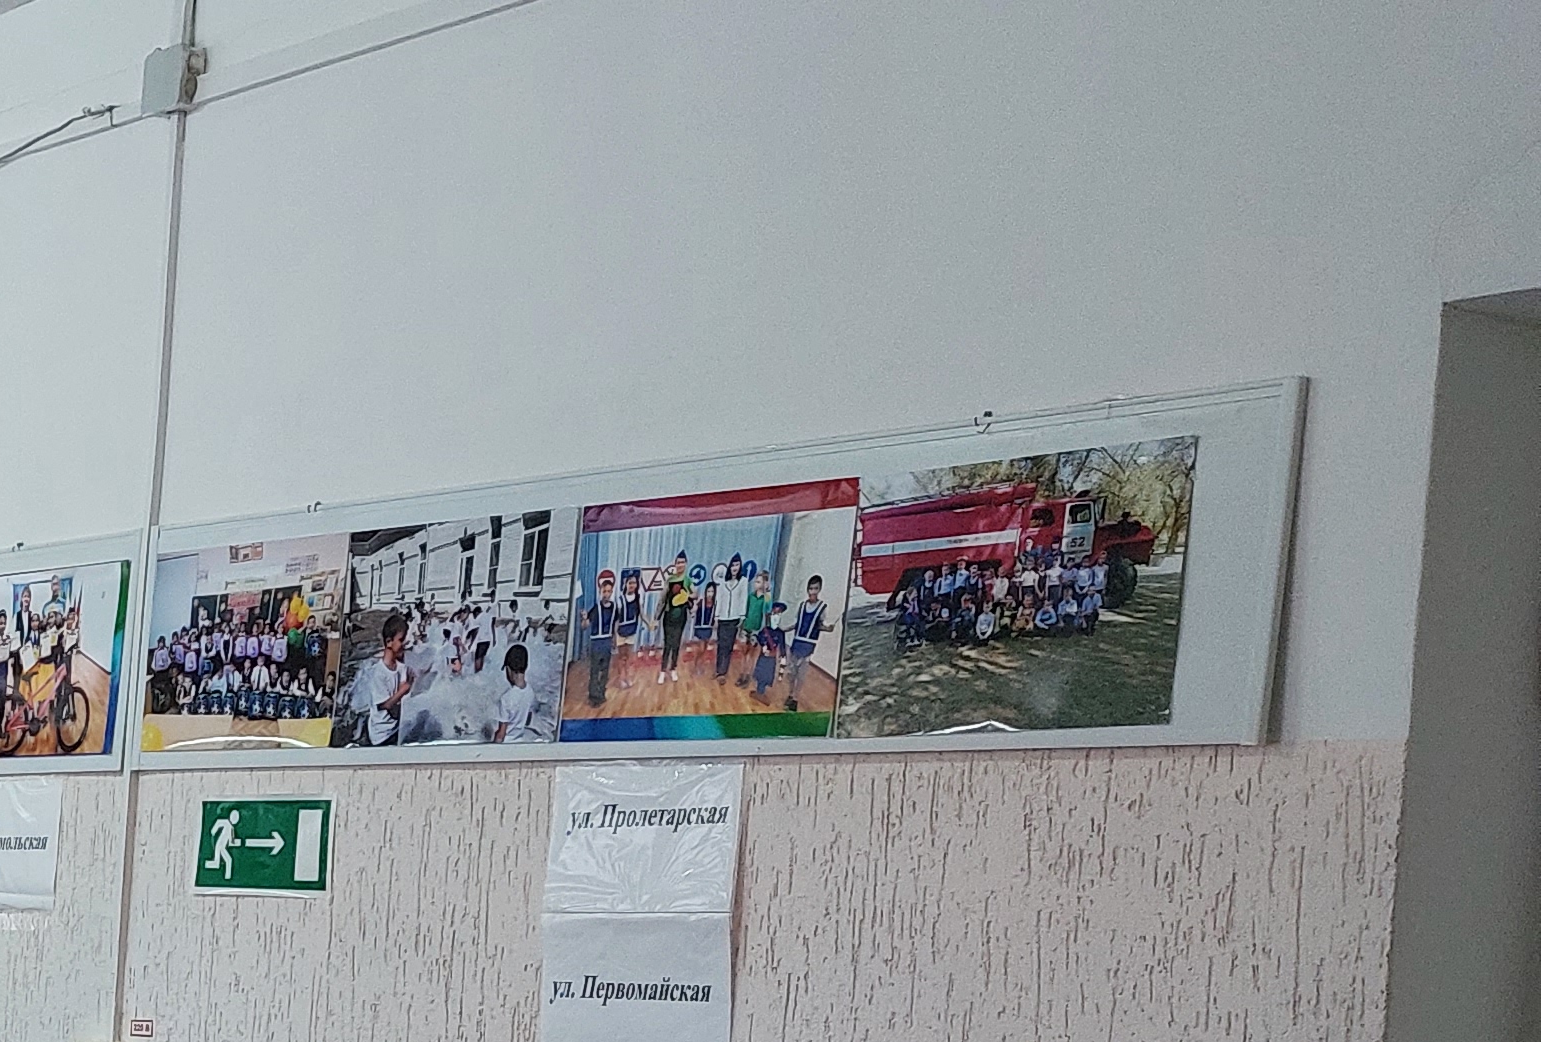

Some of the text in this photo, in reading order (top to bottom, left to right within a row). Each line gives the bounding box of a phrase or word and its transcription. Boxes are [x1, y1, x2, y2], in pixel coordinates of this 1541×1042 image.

[566, 803, 730, 837] ул. Пролетарская
[549, 974, 712, 1007] ул. Первомайская
